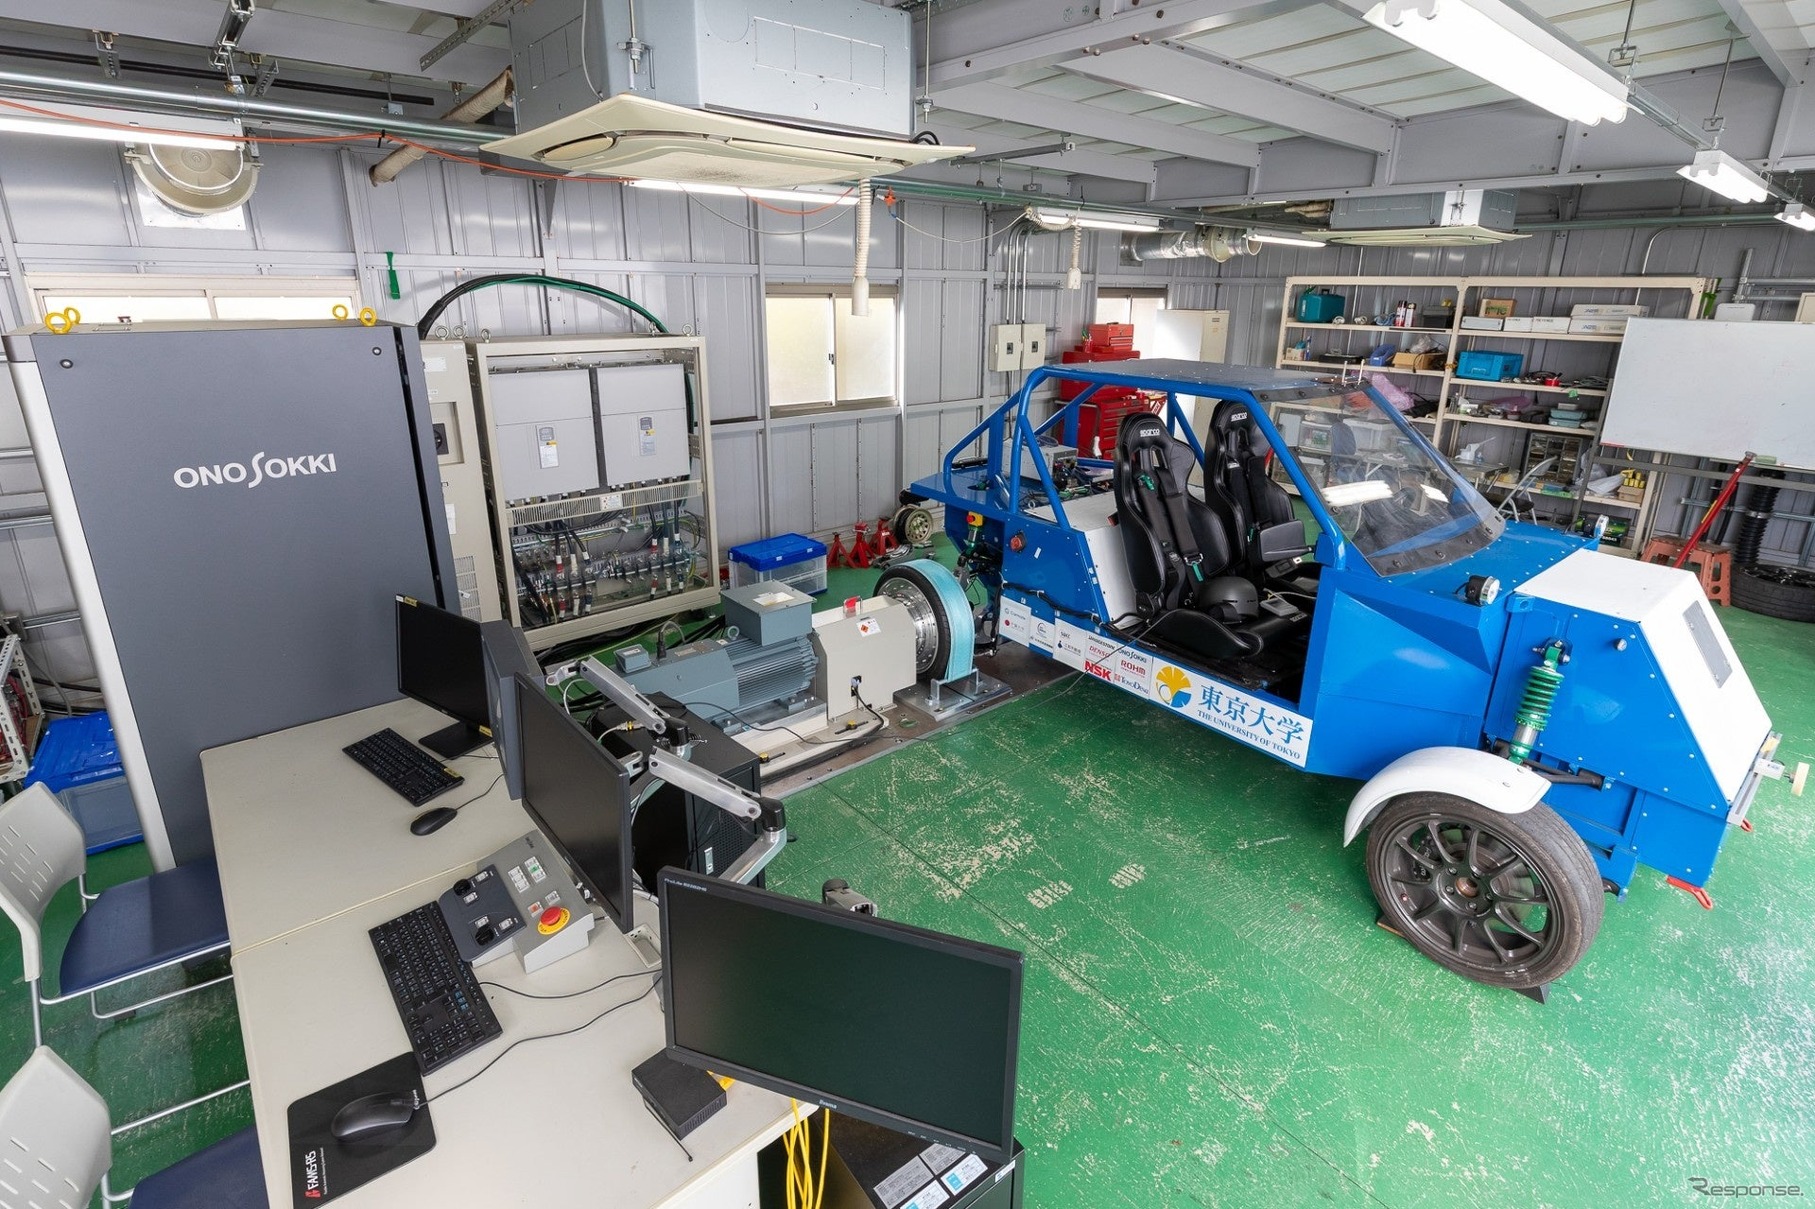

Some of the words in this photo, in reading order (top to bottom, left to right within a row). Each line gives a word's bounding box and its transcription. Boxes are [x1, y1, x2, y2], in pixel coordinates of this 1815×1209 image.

[1140, 429, 1159, 437] sparco
[1085, 660, 1112, 681] NSK
[1120, 659, 1146, 675] ROHM
[1198, 684, 1304, 744] 東京大学
[1197, 709, 1214, 723] THE
[1213, 718, 1260, 743] UNIVERSITY
[1259, 735, 1272, 748] OF
[1272, 742, 1301, 760] TOKYO
